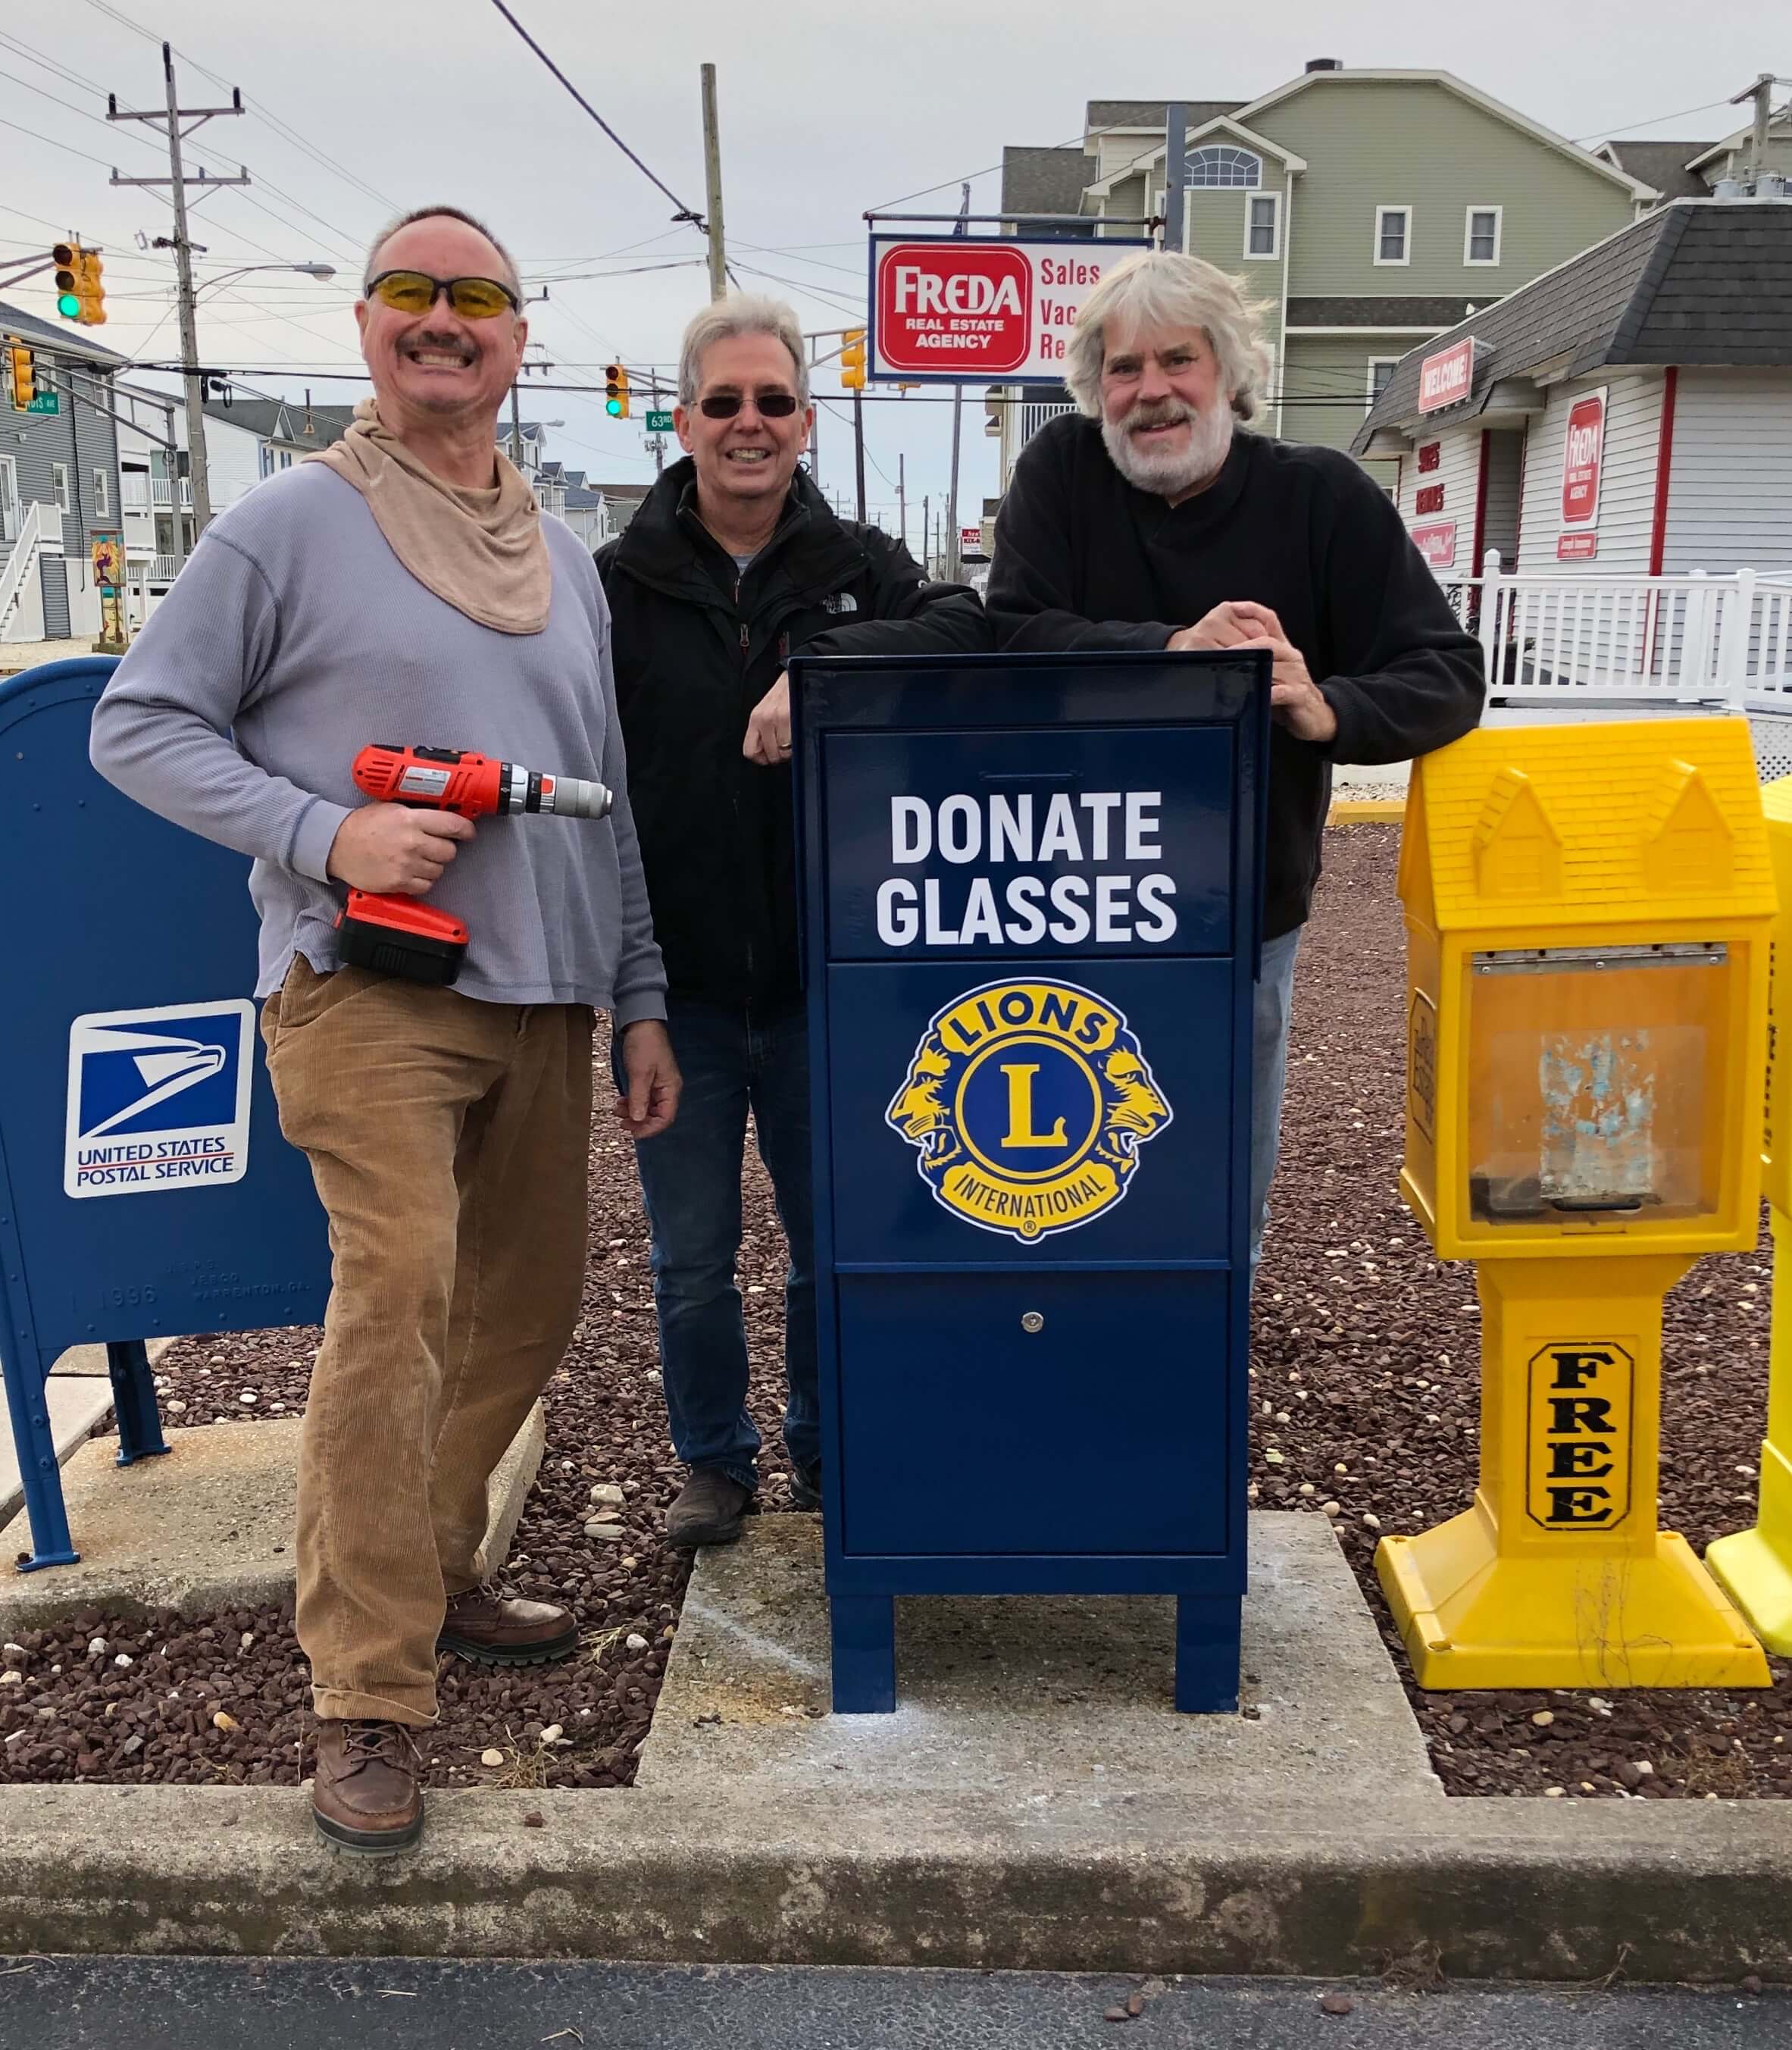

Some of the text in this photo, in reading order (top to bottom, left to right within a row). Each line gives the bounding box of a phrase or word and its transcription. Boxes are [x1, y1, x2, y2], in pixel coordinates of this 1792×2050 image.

[894, 265, 1022, 315] FREDA
[1041, 258, 1100, 285] Sales
[905, 318, 1004, 331] REAL ESTATE
[1040, 299, 1077, 326] Vac
[915, 334, 992, 349] AGENCY
[1040, 333, 1065, 359] Re
[1568, 424, 1598, 468] FREDA
[891, 791, 1162, 864] DONATE
[877, 873, 1177, 947] GLASSES
[948, 991, 1108, 1047] LIONS
[999, 1063, 1068, 1147] L
[78, 1137, 225, 1165] UNITED STATES
[77, 1156, 234, 1187] POSTAL SERVICE
[952, 1174, 1107, 1219] INTERNATIONAL
[97, 1285, 158, 1310] 1996
[1546, 1352, 1616, 1522] FREE
